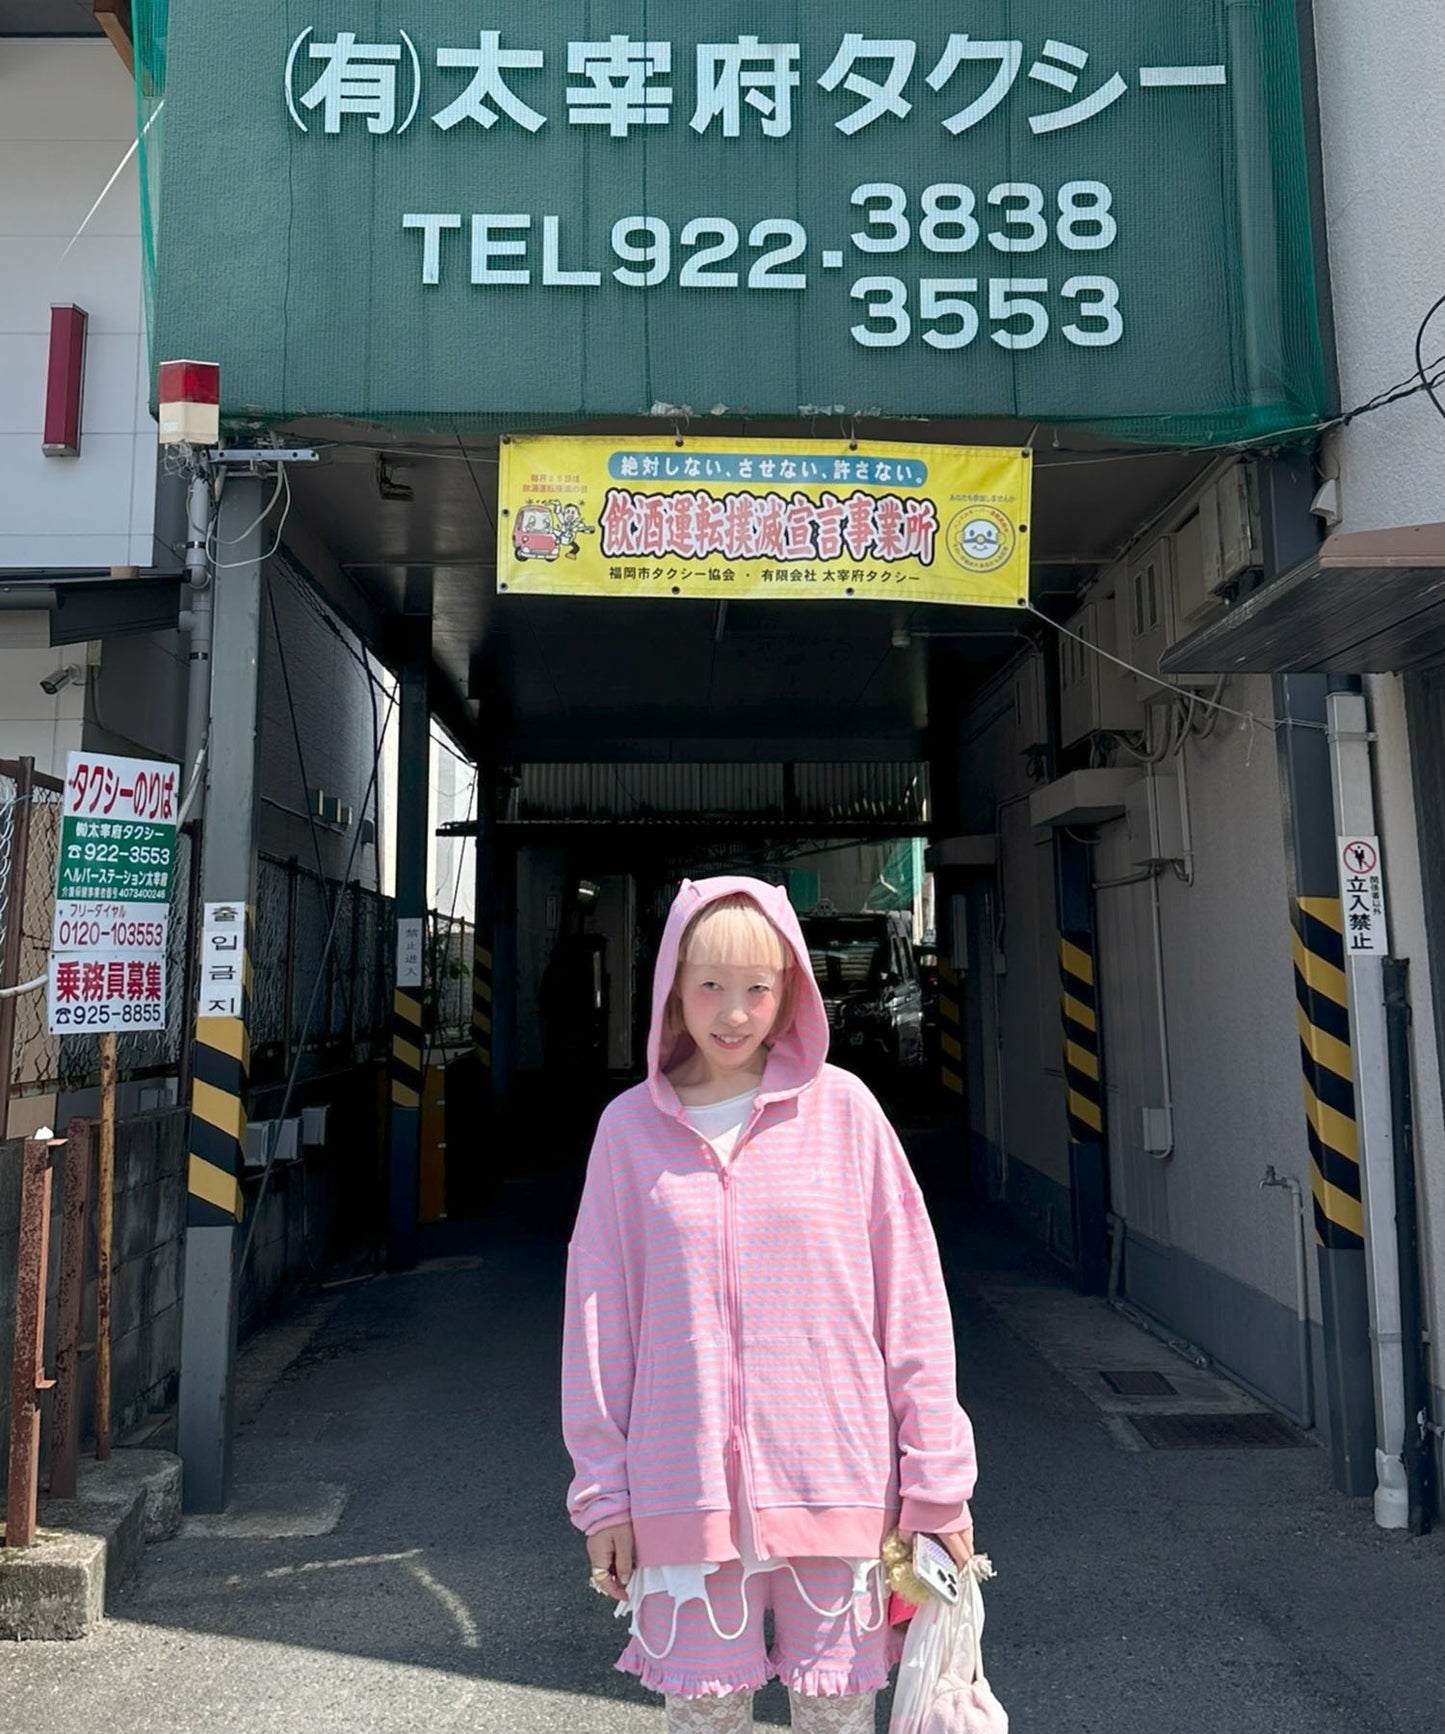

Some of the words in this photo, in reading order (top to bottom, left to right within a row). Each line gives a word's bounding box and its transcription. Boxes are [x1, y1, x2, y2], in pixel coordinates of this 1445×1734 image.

[850, 181, 1117, 254] 3838
[850, 275, 1124, 350] 3553
[602, 490, 936, 564] 飲酒運転撲滅宣言事業所
[72, 763, 175, 820] タクシーのりば
[84, 844, 171, 866] 922-3553
[58, 920, 164, 947] 0120-103553
[69, 902, 127, 918] フリーダイヤル
[1346, 875, 1374, 950] 立入禁止
[56, 960, 162, 1003] 乗務員募集
[208, 905, 239, 1014] 출입금지
[72, 1003, 162, 1025] 925-8855
